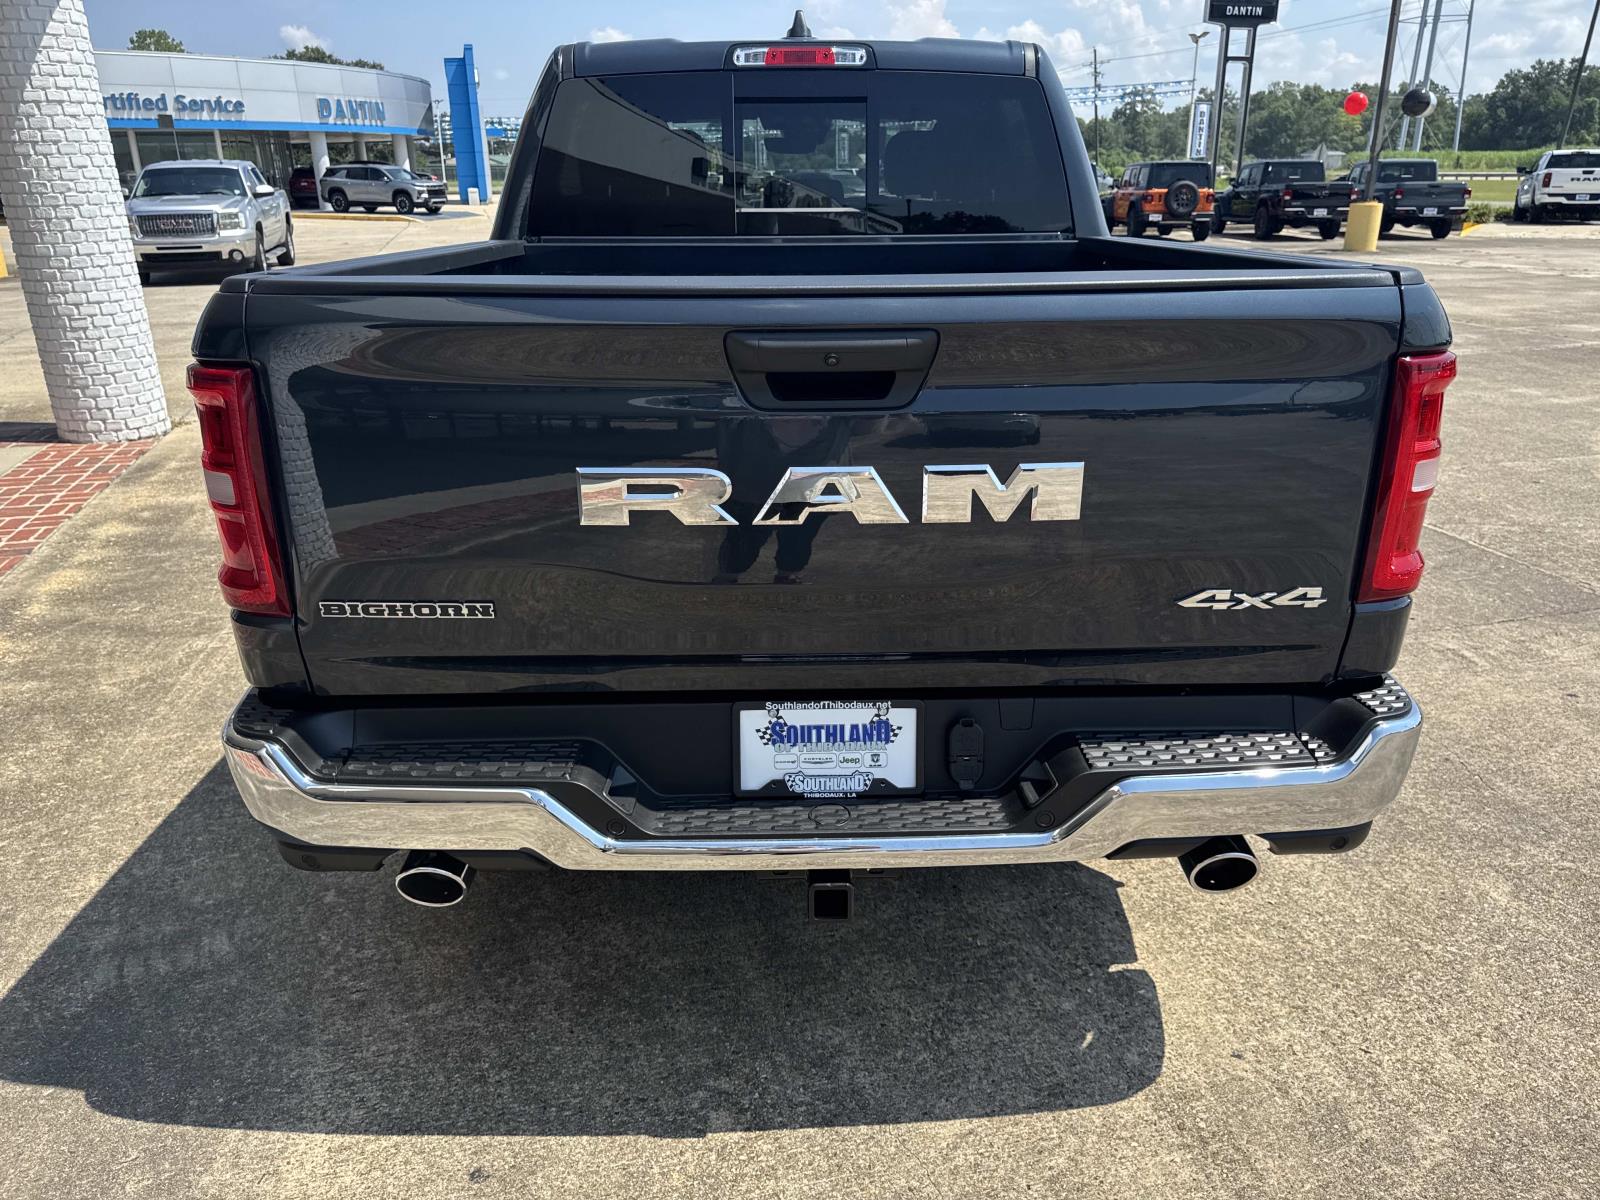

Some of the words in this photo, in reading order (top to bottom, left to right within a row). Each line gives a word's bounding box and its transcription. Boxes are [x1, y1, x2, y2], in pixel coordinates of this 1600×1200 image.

[1226, 6, 1263, 16] DANTIN
[103, 92, 168, 112] rtified
[173, 94, 246, 114] Service
[317, 98, 386, 121] DANTIN
[1196, 110, 1206, 156] DANTIN
[576, 461, 1085, 526] RAM
[1177, 586, 1328, 610] 4x4
[318, 601, 495, 619] BIGHORN
[765, 700, 892, 710] SouthlandofThibodaux.net
[839, 756, 860, 765] Jeep
[794, 774, 866, 791] SOUTHLAND
